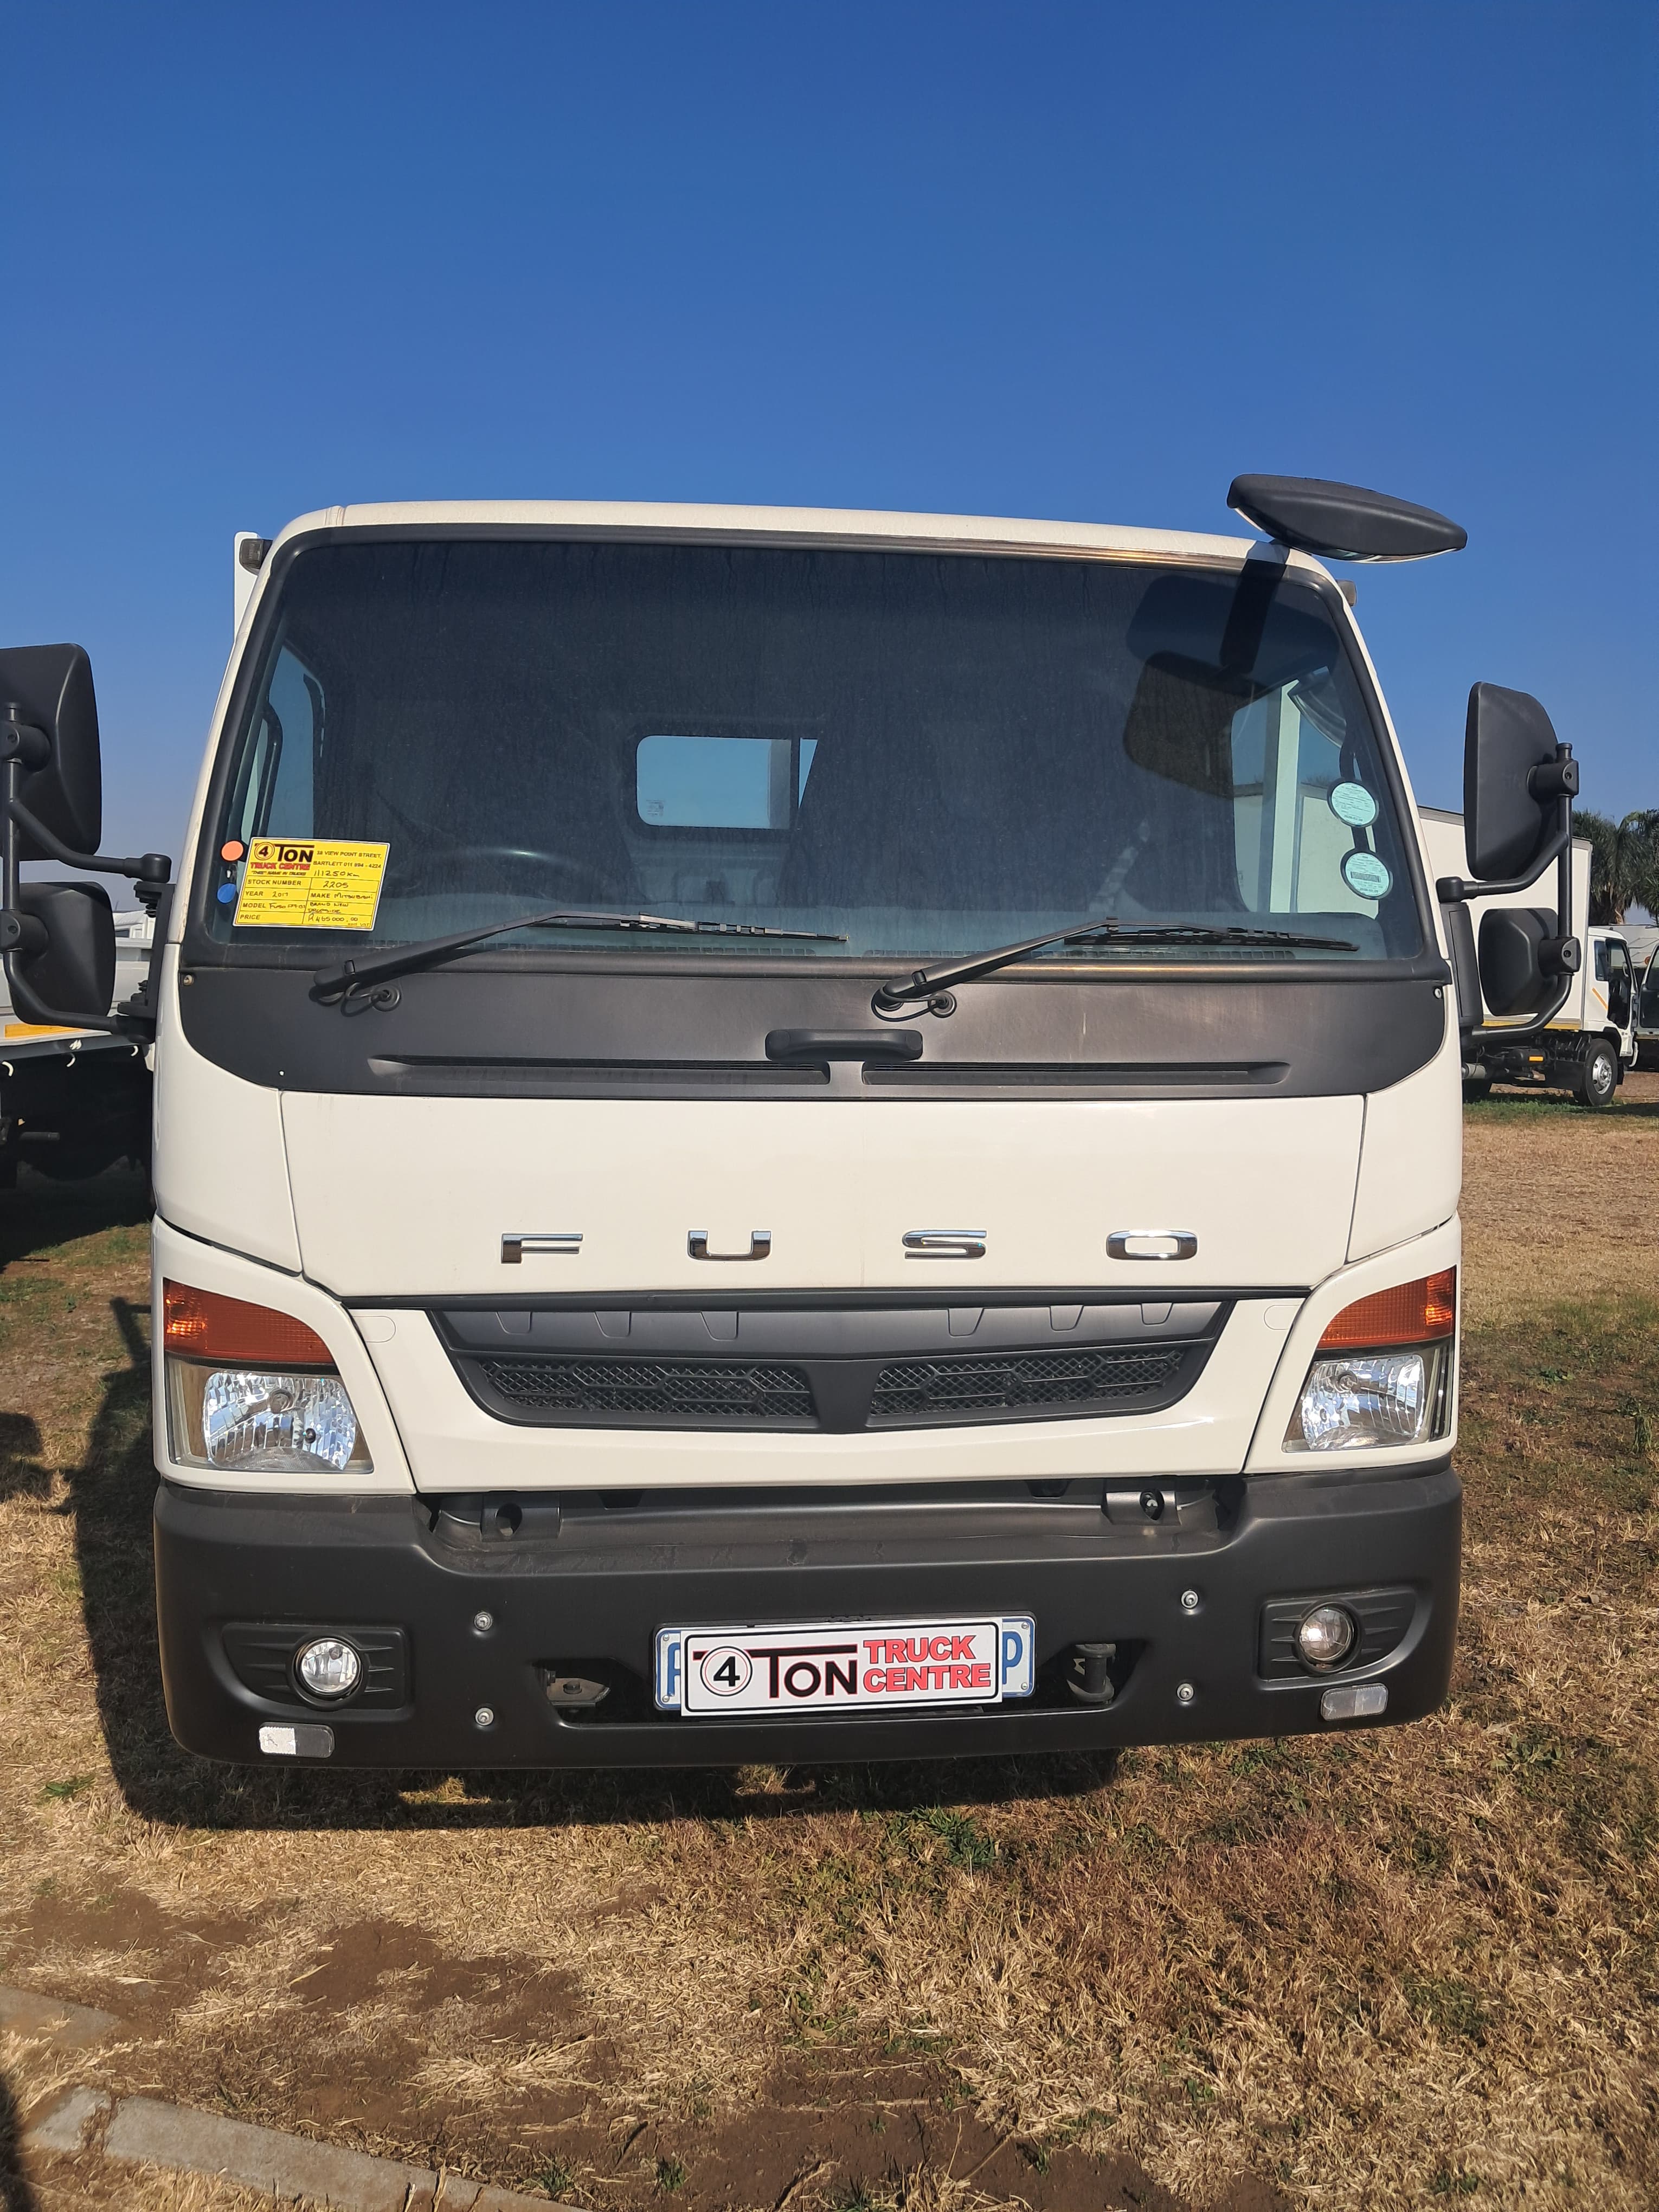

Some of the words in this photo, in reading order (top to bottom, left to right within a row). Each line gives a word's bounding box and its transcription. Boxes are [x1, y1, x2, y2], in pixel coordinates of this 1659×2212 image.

[279, 863, 311, 871] CENTRE
[500, 1228, 1199, 1265] FUSO
[863, 1634, 977, 1664] TRUCK
[712, 1656, 741, 1687] 4
[863, 1663, 992, 1693] CENTRE
